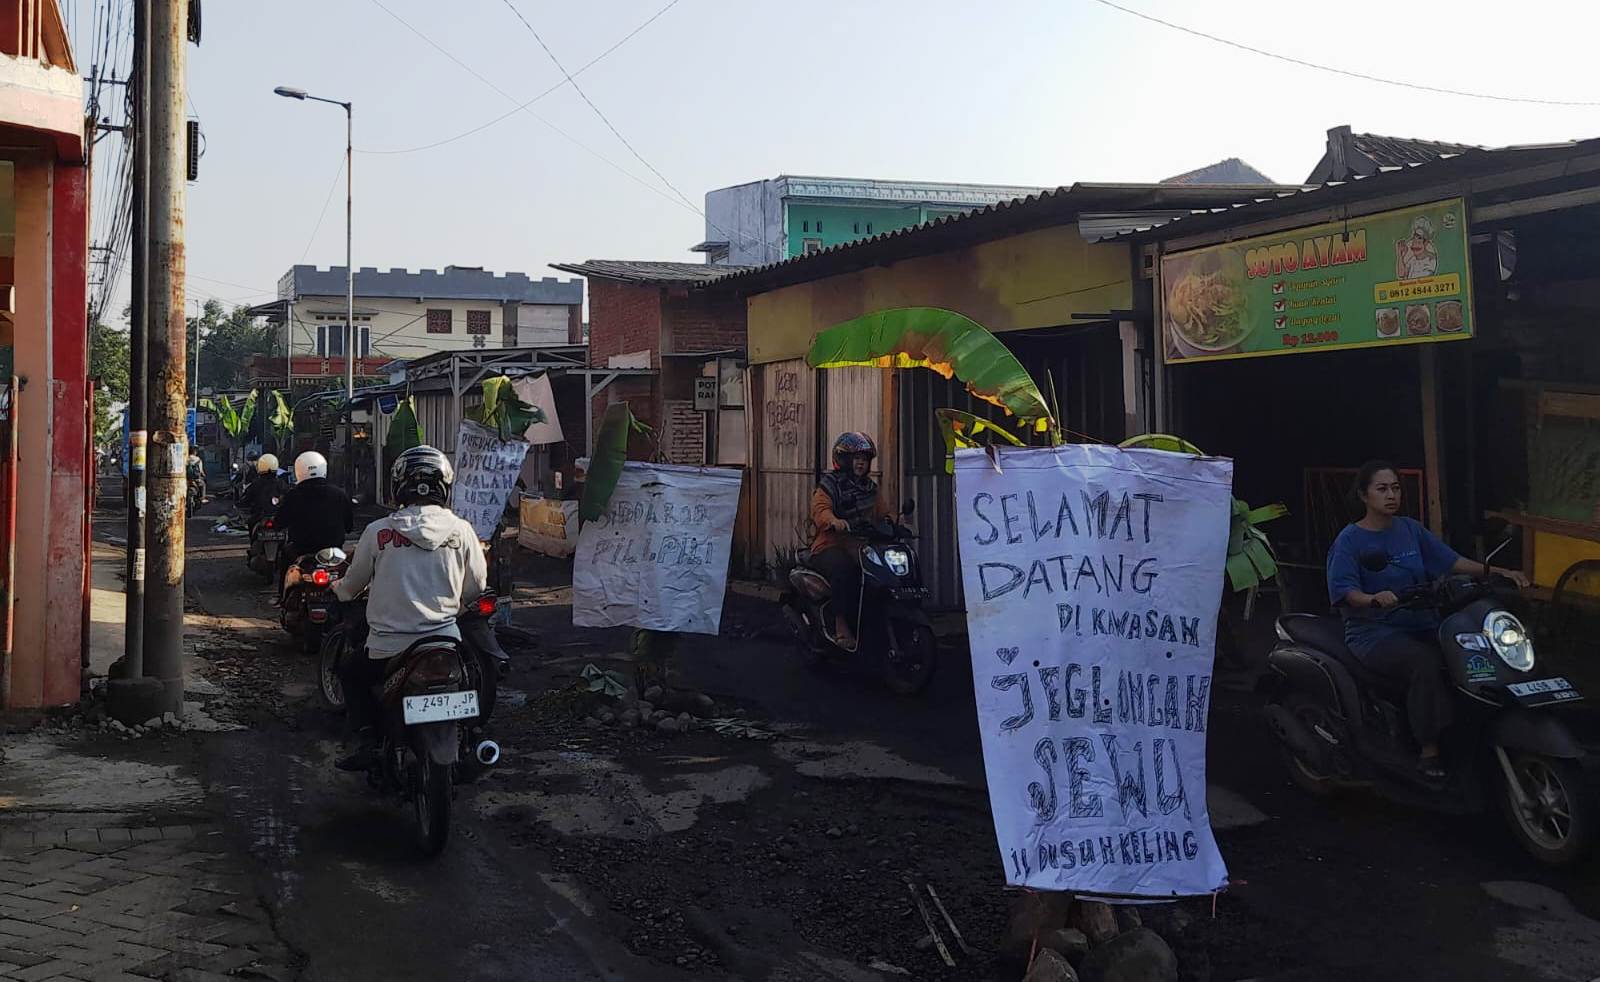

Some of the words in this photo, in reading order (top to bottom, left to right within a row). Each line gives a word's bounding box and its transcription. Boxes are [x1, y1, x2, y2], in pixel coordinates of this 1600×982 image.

[1246, 242, 1298, 278] SOTO
[1300, 230, 1367, 269] AYAM
[972, 488, 1164, 546] SELAMAT
[977, 554, 1160, 602] DATANG
[406, 698, 414, 711] K
[423, 695, 450, 709] 2497
[461, 692, 475, 705] JP
[1027, 733, 1192, 823] SEWU
[1039, 836, 1116, 873] DUSUN
[1119, 830, 1199, 866] KELING
